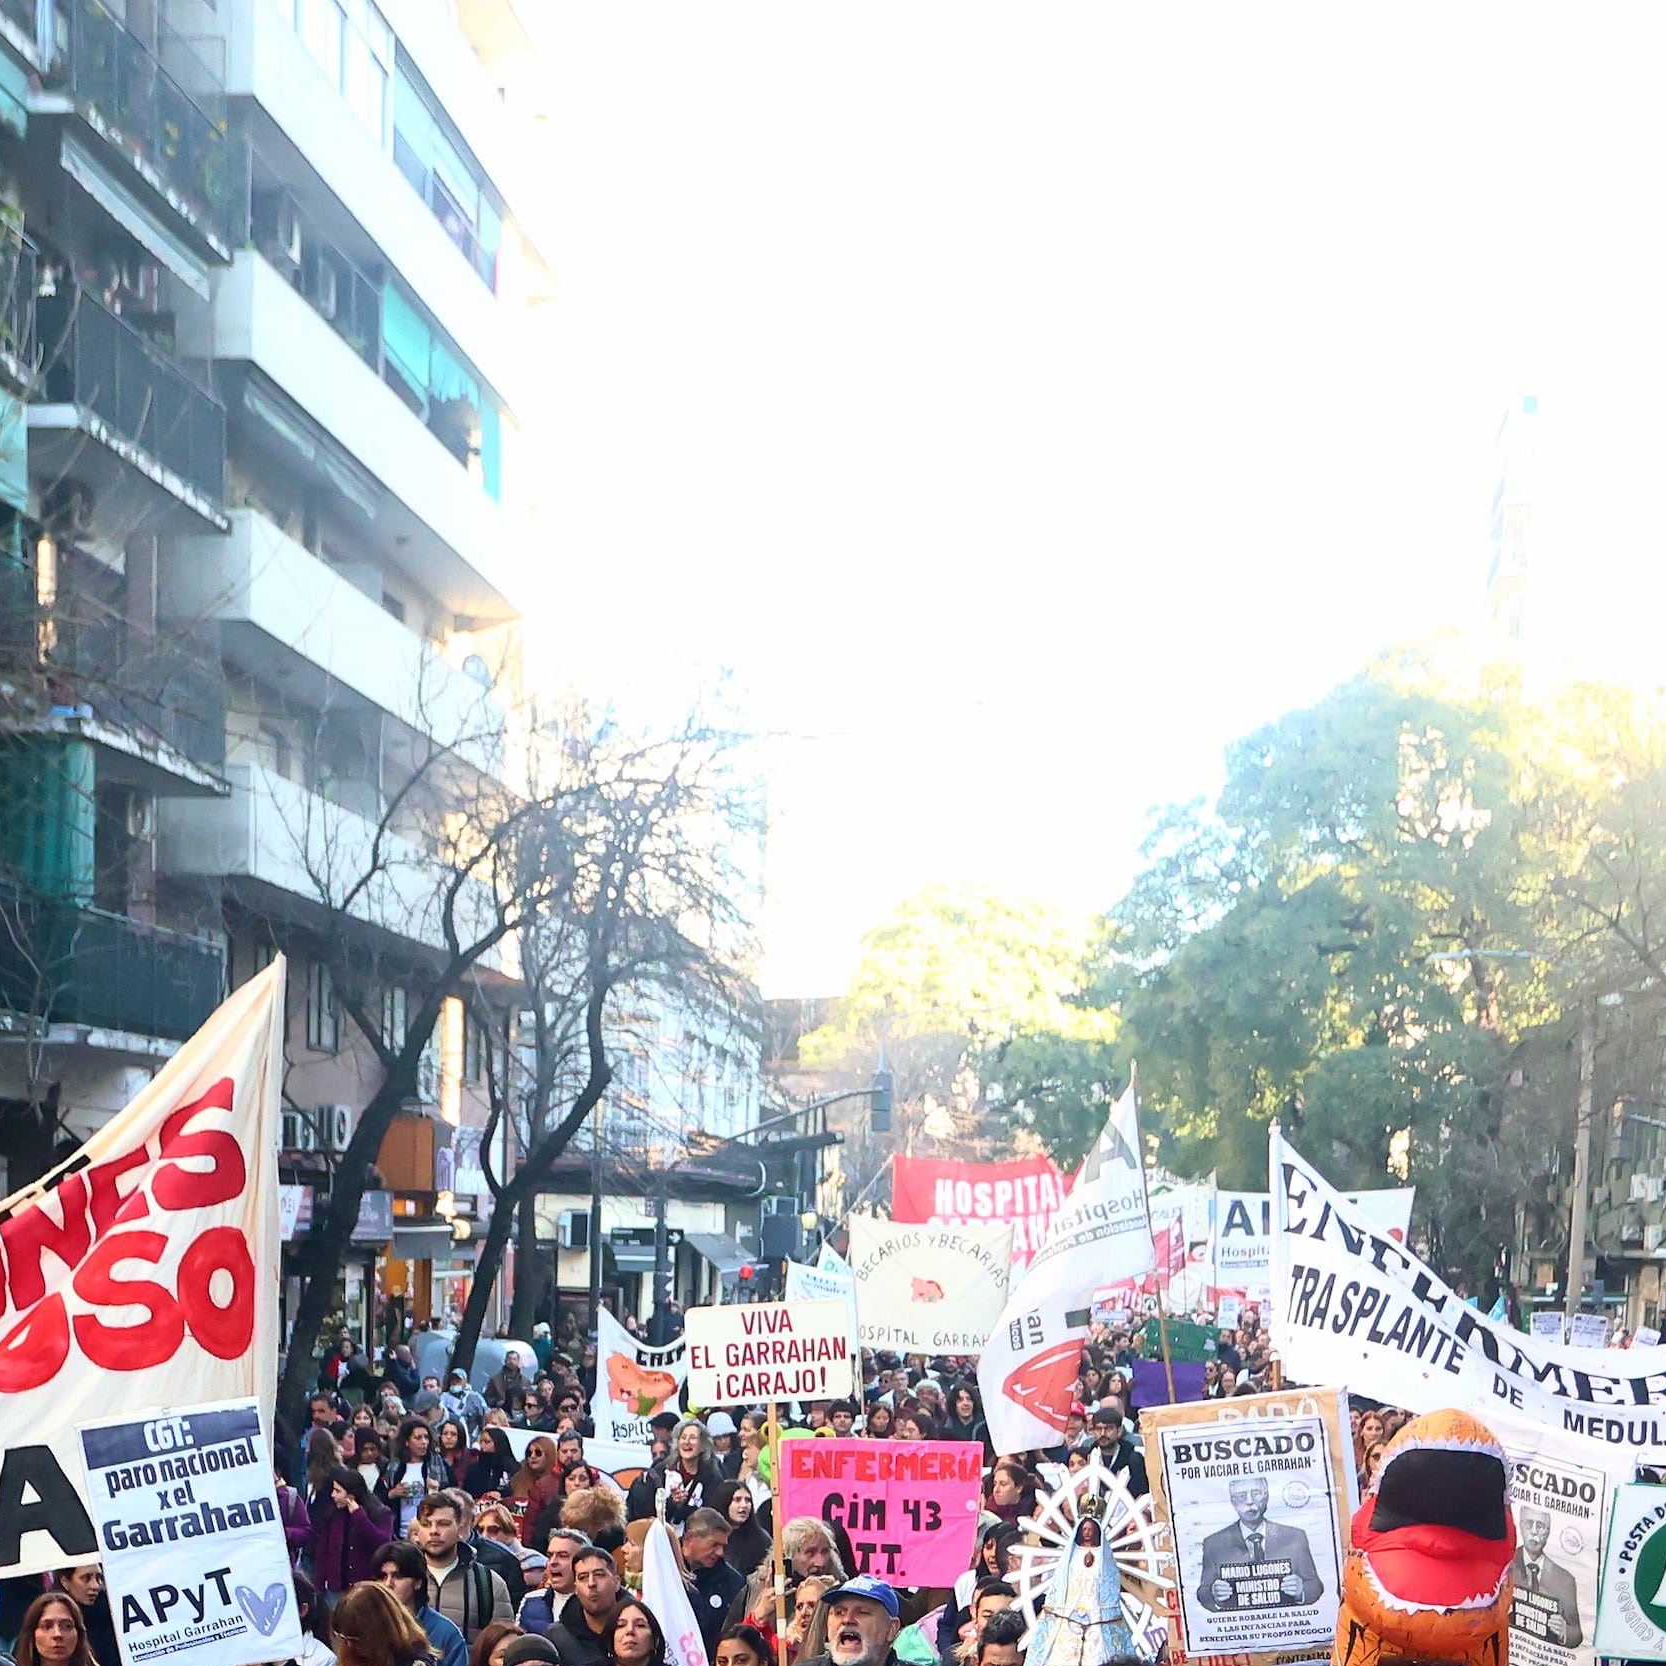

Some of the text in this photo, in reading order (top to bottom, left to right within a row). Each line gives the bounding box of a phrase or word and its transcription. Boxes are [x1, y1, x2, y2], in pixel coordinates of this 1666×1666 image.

[856, 1231, 922, 1282] BECARIOS
[939, 1232, 1010, 1290] BECARIAS
[741, 1309, 793, 1336] VIVA
[691, 1336, 847, 1370] EL GARRAHAN
[716, 1366, 827, 1401] ¡CARAJO!
[1493, 1373, 1525, 1410] DE
[143, 1416, 194, 1453] CGT:
[1172, 1432, 1316, 1465] BUSCADO
[105, 1443, 258, 1499] paro nacional
[791, 1448, 983, 1483] ENFERMERÍA
[1204, 1464, 1241, 1479] VACIAR
[1243, 1462, 1255, 1475] EL
[157, 1481, 196, 1510] x el
[1533, 1493, 1543, 1506] EL
[102, 1496, 276, 1552] Garrahan
[903, 1499, 943, 1532] 43
[1619, 1515, 1656, 1563] POSTA
[1220, 1562, 1292, 1580] MARIO LUGONES
[1235, 1577, 1281, 1593] MINISTRO
[121, 1567, 233, 1634] APyT
[1238, 1591, 1281, 1606] DE SALUD
[1206, 1614, 1238, 1625] QUIERE
[1291, 1608, 1319, 1619] SALUD
[1240, 1621, 1284, 1633] INFANCIAS
[1285, 1618, 1312, 1629] PARA
[128, 1614, 244, 1653] Hospital Garrahan
[1199, 1625, 1333, 1644] BENEFICIAR SU PROPIO NEGOCIO
